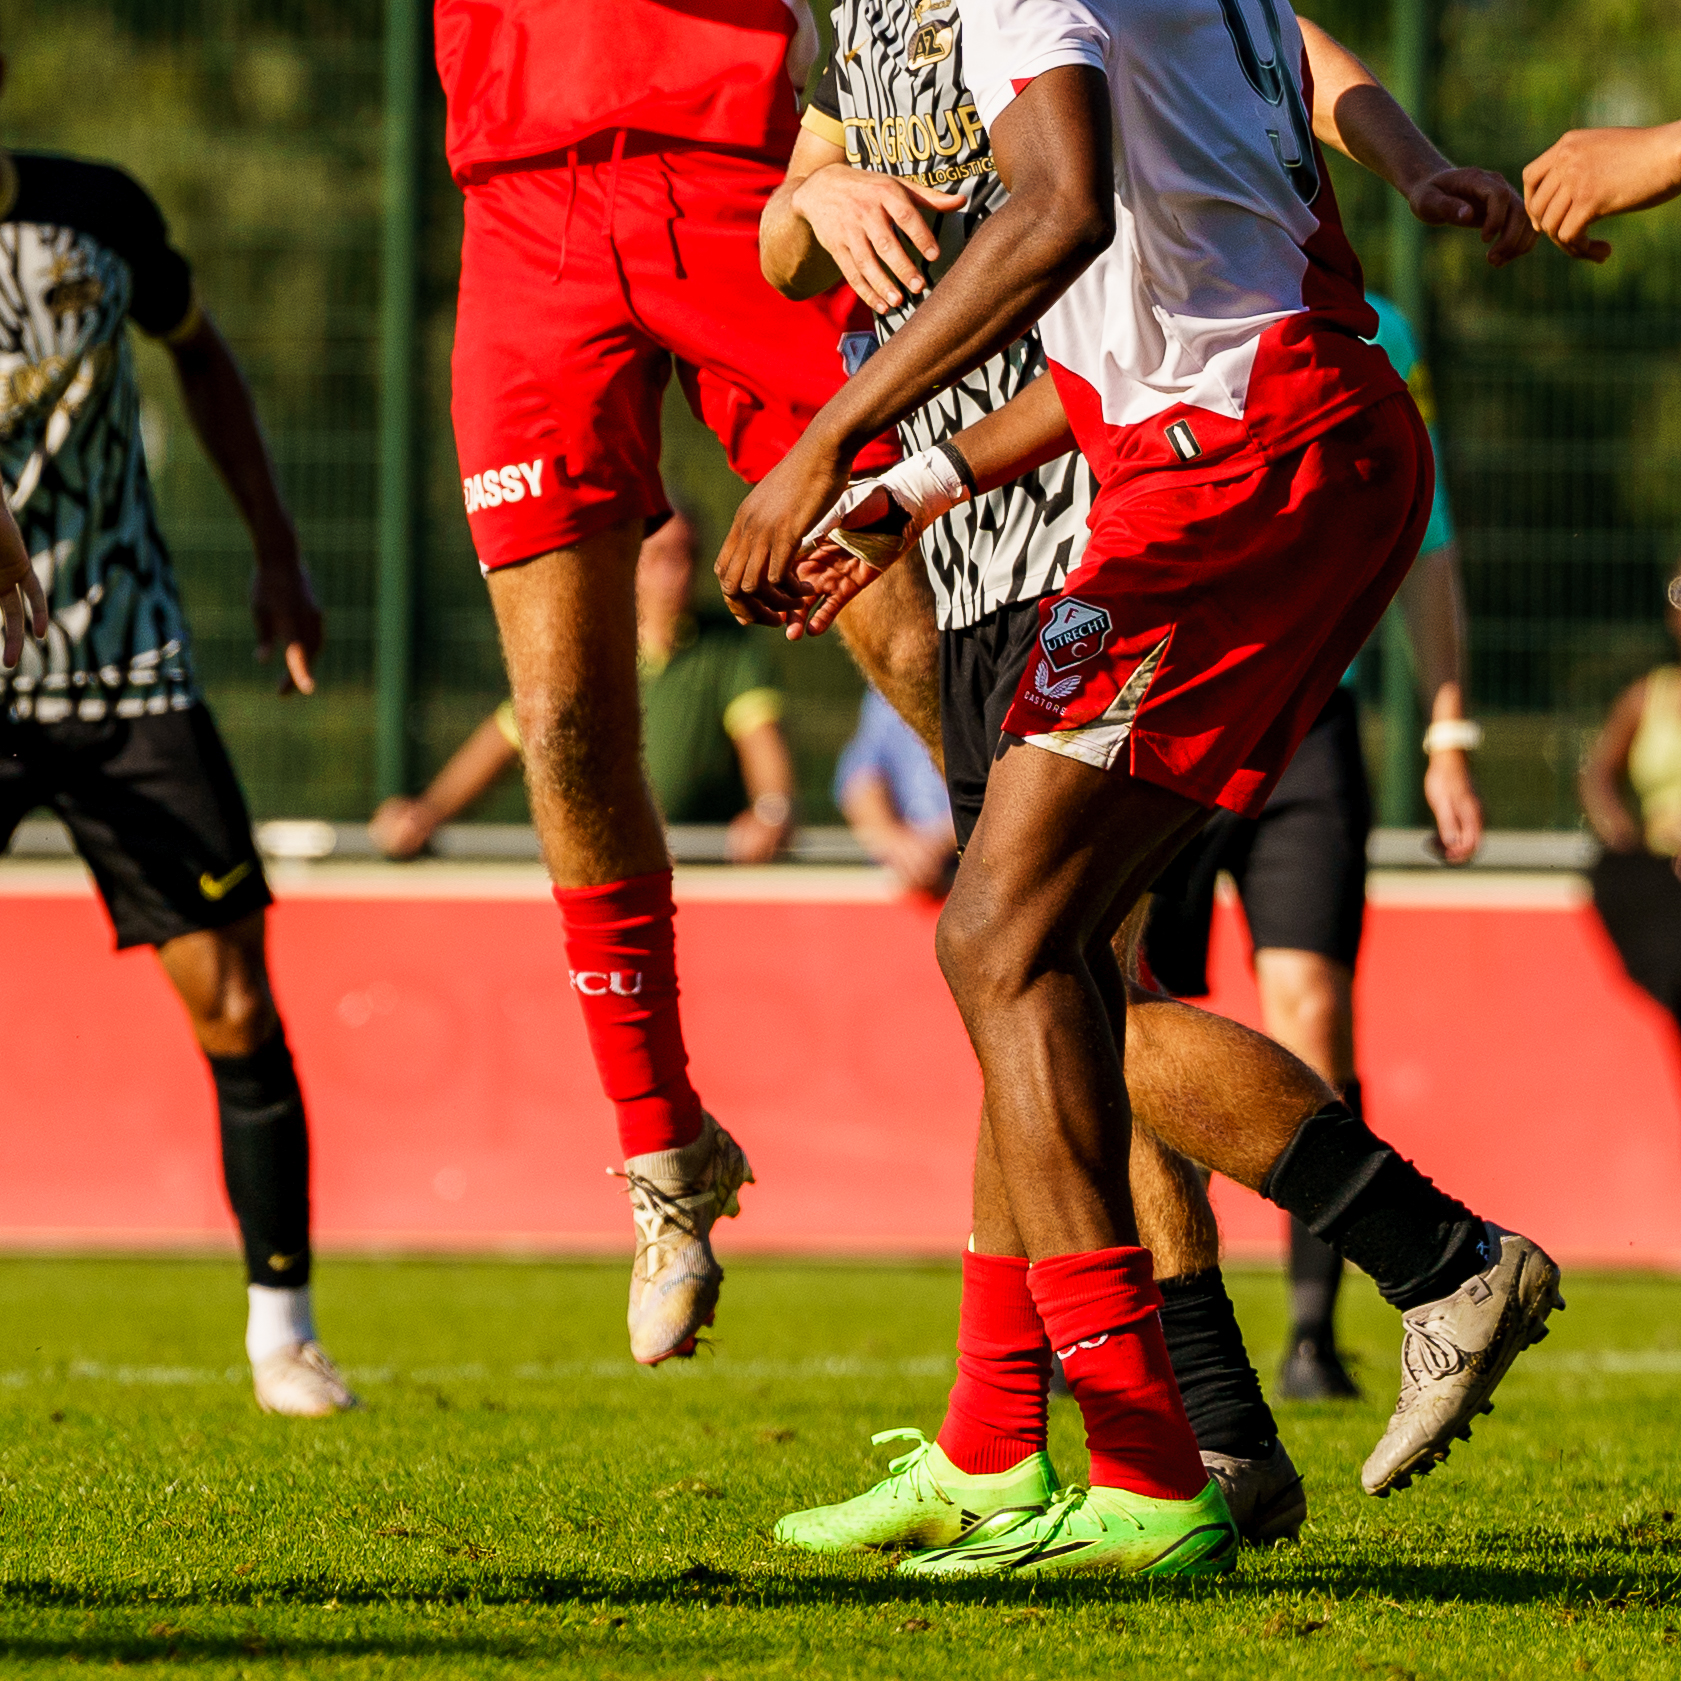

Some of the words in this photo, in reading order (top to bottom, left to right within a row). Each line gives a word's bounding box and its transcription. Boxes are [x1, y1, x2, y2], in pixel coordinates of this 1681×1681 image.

[911, 25, 946, 65] AZ
[881, 104, 984, 164] GROUP
[463, 458, 543, 515] DASSY
[1063, 607, 1079, 624] F
[1046, 616, 1106, 651] UTRECHT
[1071, 641, 1088, 658] C
[1023, 690, 1069, 716] CASTORE
